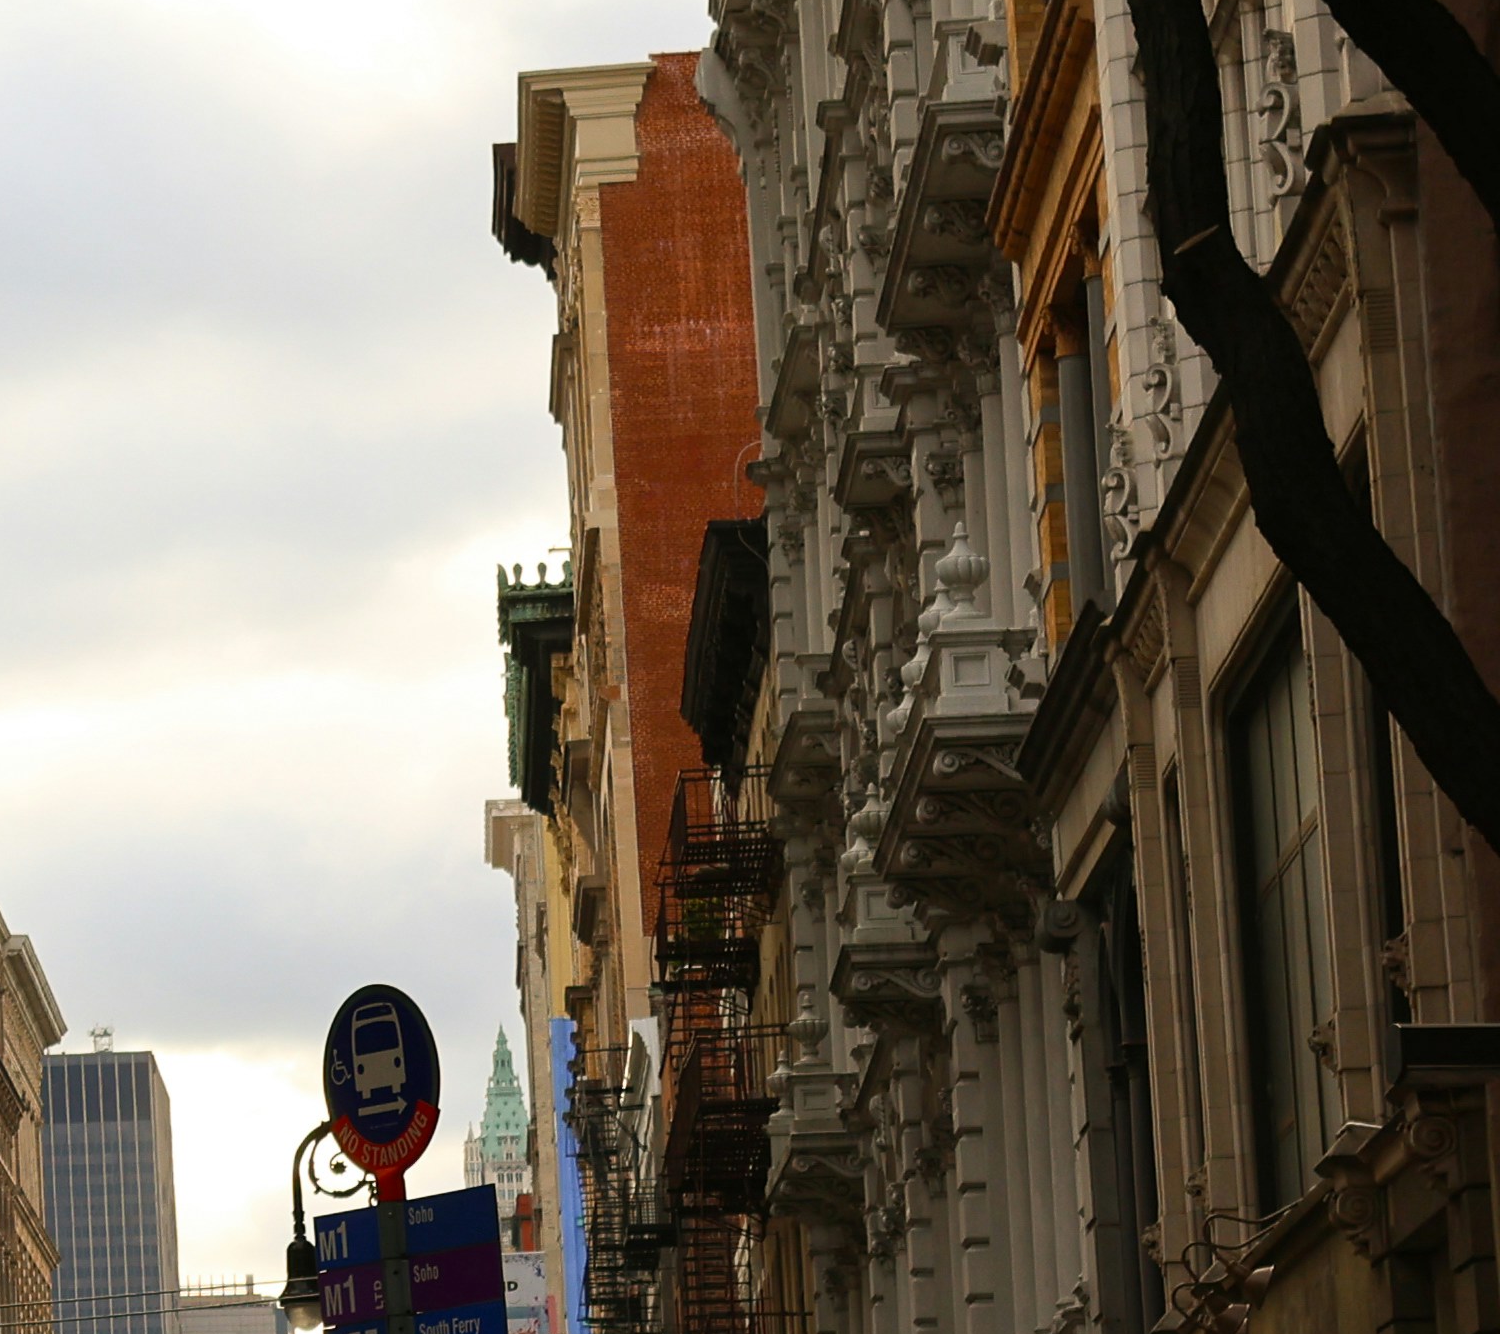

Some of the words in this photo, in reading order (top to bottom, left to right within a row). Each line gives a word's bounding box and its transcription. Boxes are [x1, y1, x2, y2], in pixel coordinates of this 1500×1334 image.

[340, 1123, 359, 1154] NO
[361, 1111, 428, 1166] STANDING
[408, 1205, 434, 1225] Soho
[319, 1221, 348, 1262] M1
[413, 1263, 439, 1283] Soho
[325, 1274, 356, 1317] M1
[373, 1280, 385, 1310] LTD
